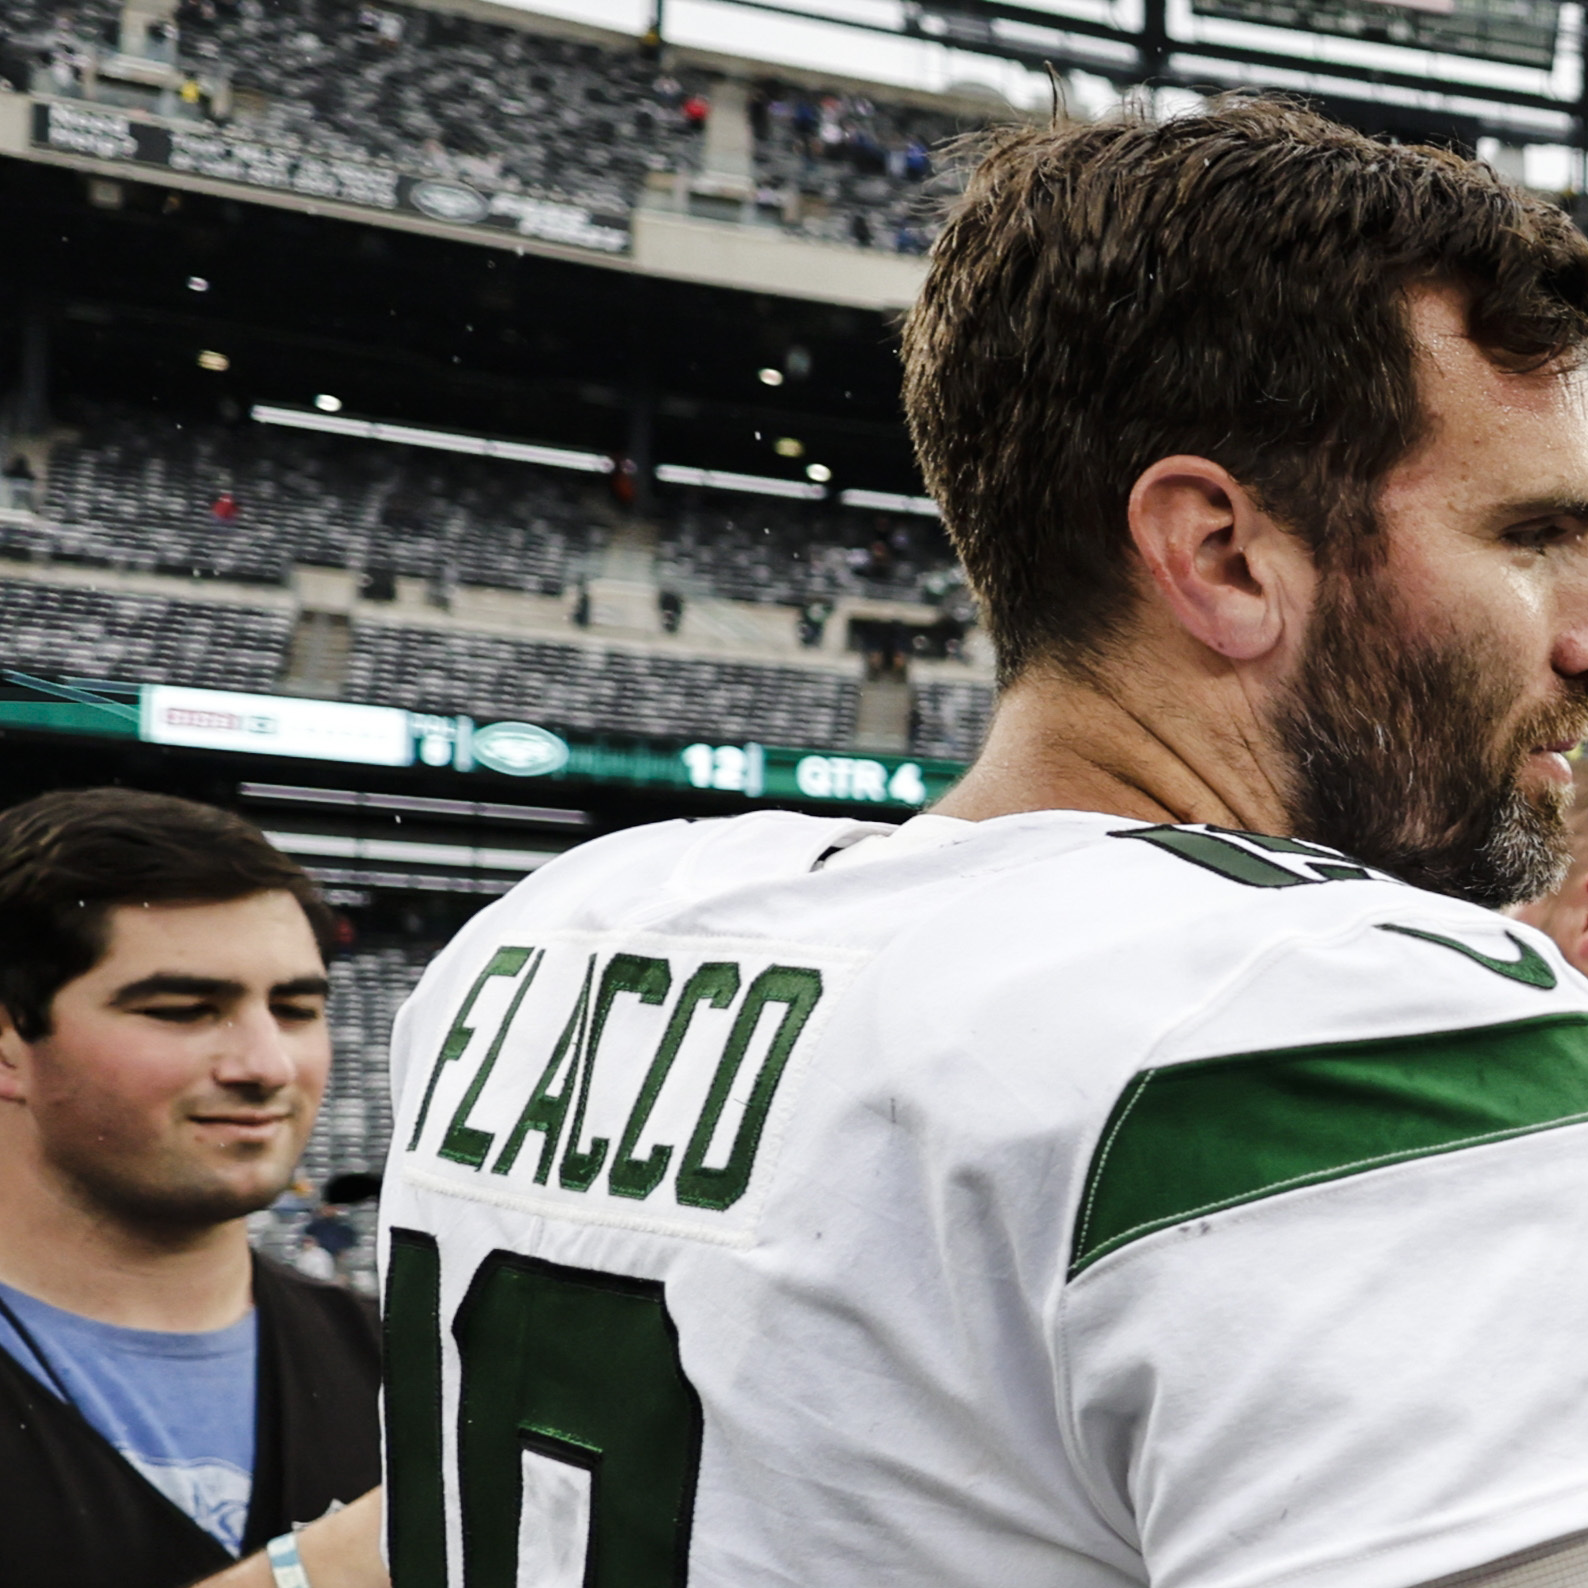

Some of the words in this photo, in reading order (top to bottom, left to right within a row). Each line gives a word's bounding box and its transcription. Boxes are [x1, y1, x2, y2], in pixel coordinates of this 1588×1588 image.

[681, 742, 745, 792] 12
[796, 754, 888, 803] QTR
[886, 761, 926, 806] 4
[406, 944, 824, 1212] FLACCO
